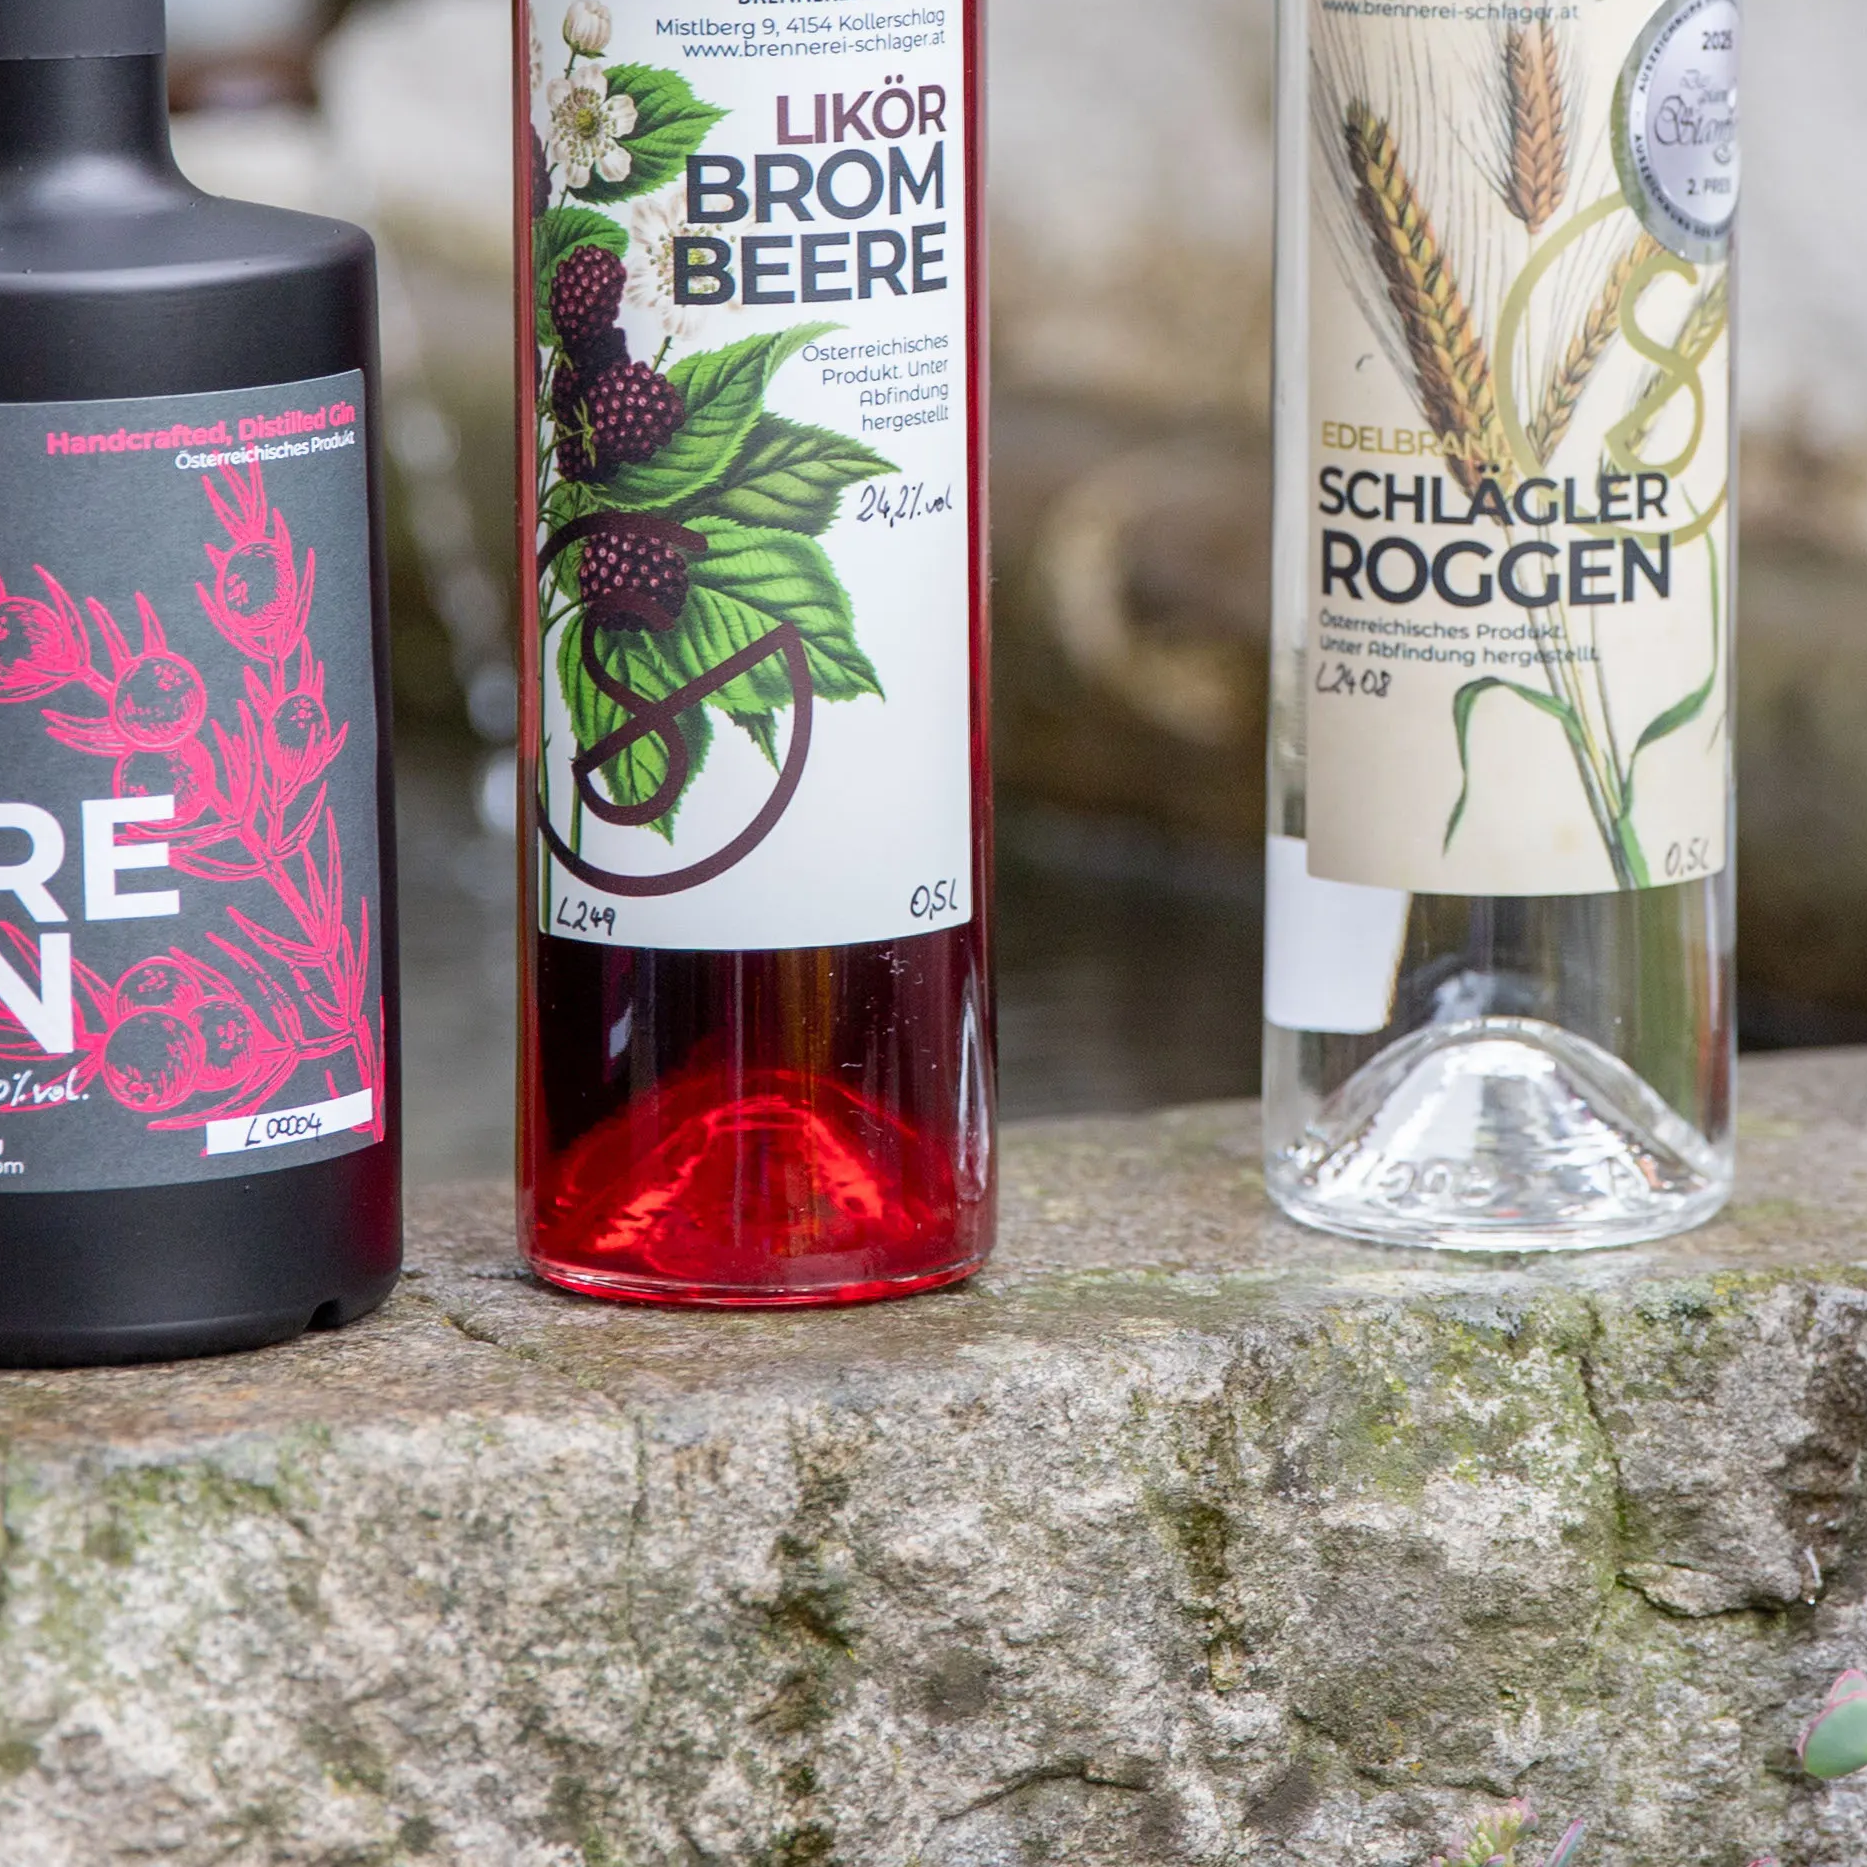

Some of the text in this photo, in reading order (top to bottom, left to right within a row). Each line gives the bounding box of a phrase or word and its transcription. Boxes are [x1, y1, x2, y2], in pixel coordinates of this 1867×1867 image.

[655, 8, 946, 40] Mistlberg 9, 4154 Kollerschlag
[682, 29, 946, 59] www.brennerei-schlager.at
[776, 74, 947, 145] LIKÖR
[686, 140, 944, 224] BROM
[673, 221, 947, 306] BEERE
[802, 334, 949, 363] Österreichisches
[822, 358, 949, 386] Produkt. Unter
[859, 382, 950, 408] Abfindung
[47, 400, 356, 455] Handcrafted, Distilled Gin
[862, 403, 950, 432] hergestellt
[175, 429, 356, 470] Österreichisches Produkt
[1318, 463, 1669, 527] SCHLÄGLER
[1321, 529, 1671, 608] ROGGEN
[1319, 608, 1470, 640] Österreichisches
[1320, 634, 1362, 655] Unter
[1368, 640, 1475, 667] Abfindung
[556, 896, 616, 937] L249
